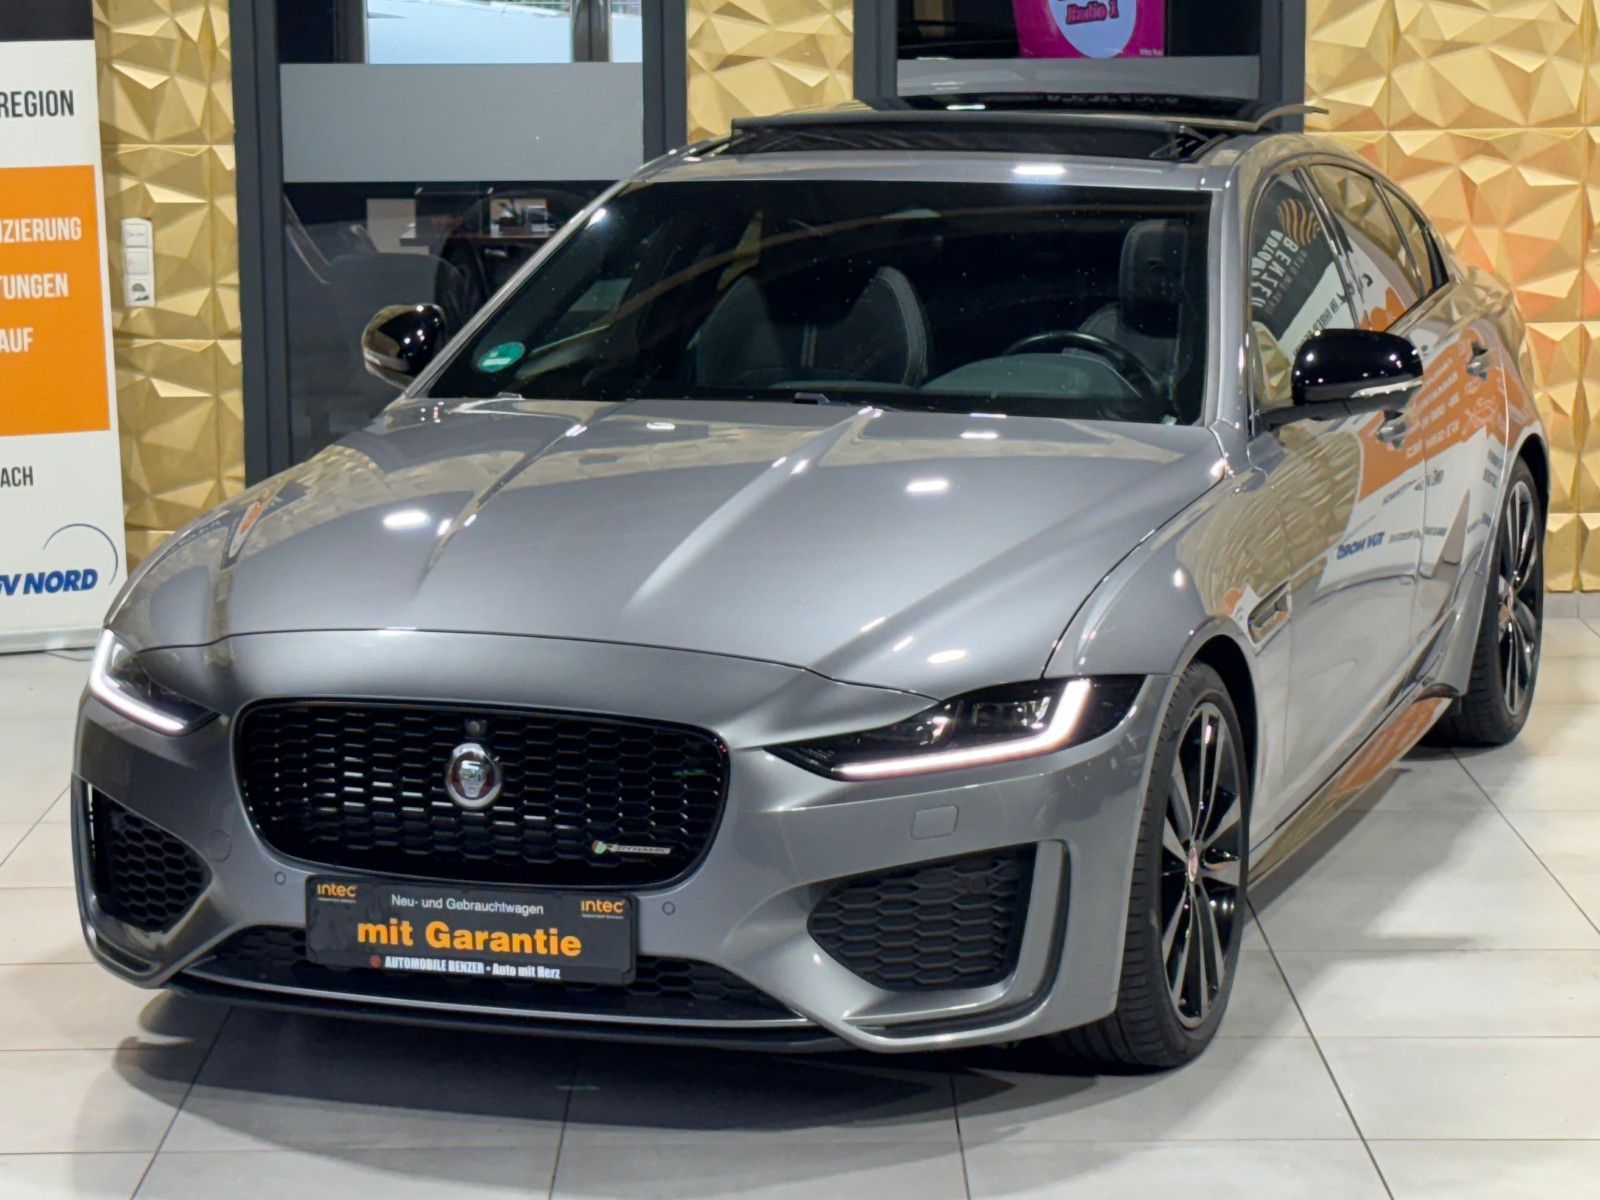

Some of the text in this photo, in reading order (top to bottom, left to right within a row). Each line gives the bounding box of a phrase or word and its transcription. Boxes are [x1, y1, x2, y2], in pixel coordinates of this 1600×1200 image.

[0, 90, 74, 118] REGION
[0, 216, 82, 243] ZIERUNG
[23, 568, 98, 595] NORD
[391, 893, 544, 917] Neu- und Gebrauchtwagen
[581, 898, 625, 914] intec
[357, 917, 582, 957] mit Garantie
[384, 955, 447, 972] AUTOMOBILE
[447, 960, 485, 975] BENZER
[492, 963, 516, 977] Auto
[518, 965, 536, 977] mit
